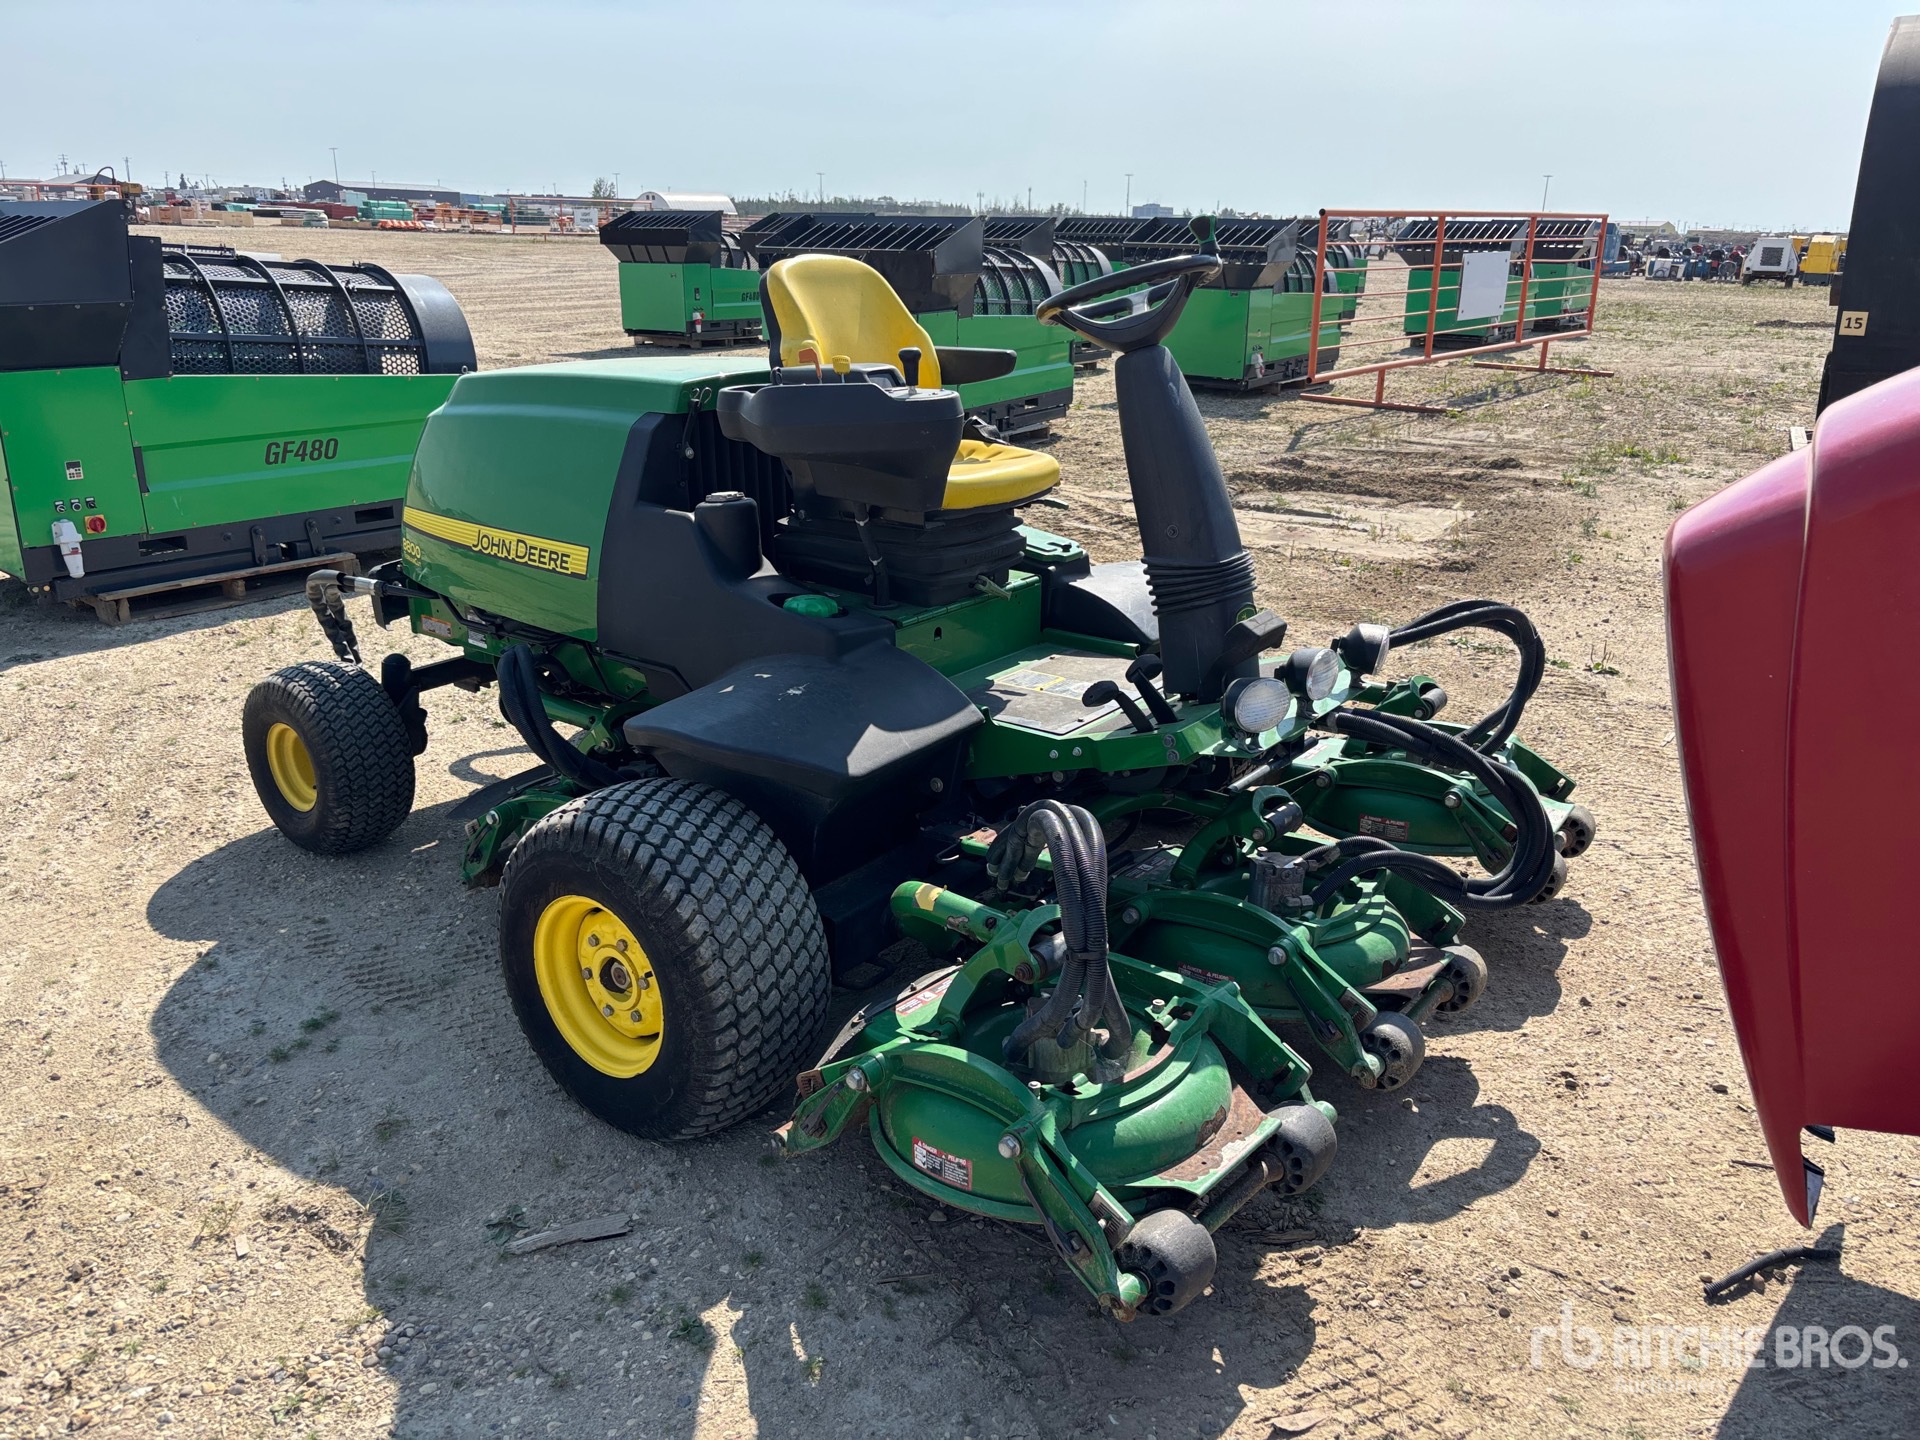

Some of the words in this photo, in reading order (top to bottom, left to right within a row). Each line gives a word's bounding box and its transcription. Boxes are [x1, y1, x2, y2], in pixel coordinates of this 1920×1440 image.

[1844, 317, 1863, 329] 15
[265, 438, 339, 465] GF480
[472, 529, 512, 558] JOHN
[515, 539, 571, 572] DEERE
